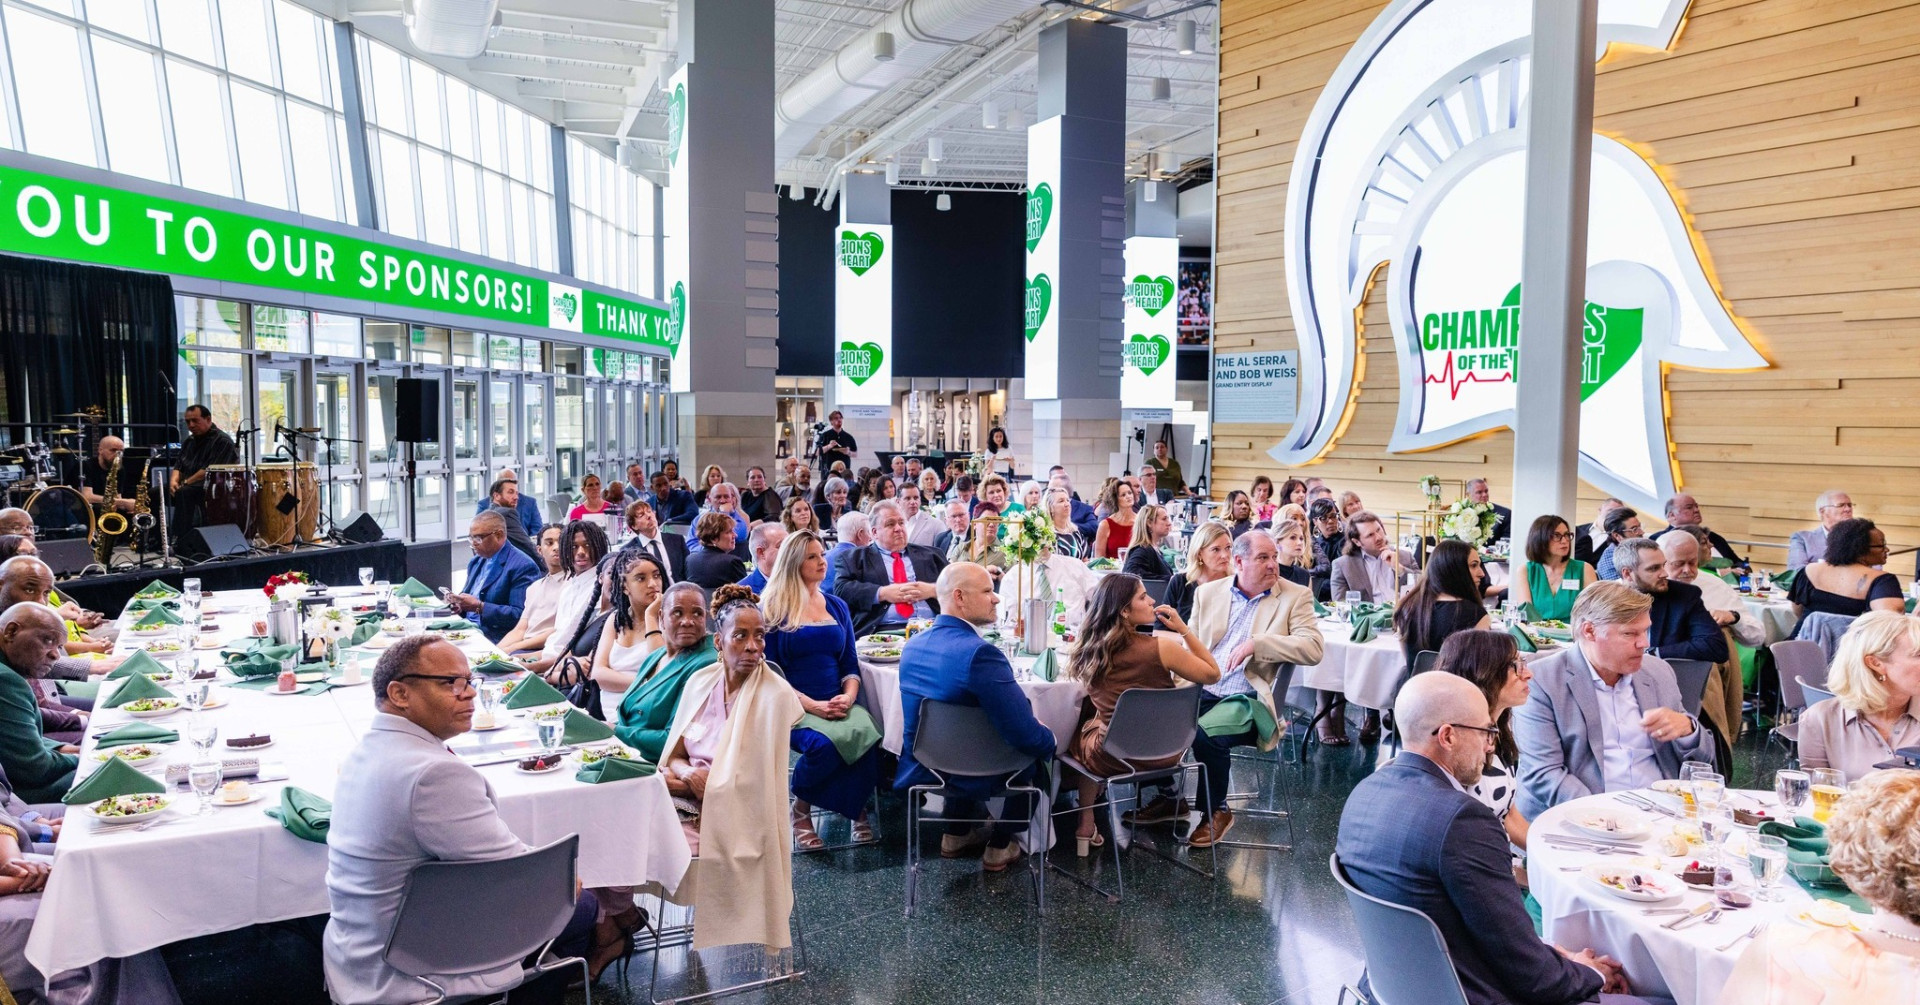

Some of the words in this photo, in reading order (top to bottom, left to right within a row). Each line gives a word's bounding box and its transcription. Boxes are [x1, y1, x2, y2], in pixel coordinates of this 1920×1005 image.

[0, 180, 111, 246] OU
[146, 208, 218, 263] TO
[246, 228, 336, 282] OUR
[358, 250, 533, 315] SPONSORS!
[1135, 297, 1162, 308] HEART
[596, 302, 648, 338] THANK
[1131, 356, 1158, 367] HEART
[1216, 358, 1235, 367] THE
[1237, 357, 1250, 367] AL
[1253, 355, 1287, 366] SERRA
[1457, 355, 1477, 370] OF
[1479, 353, 1509, 370] THE
[1216, 370, 1237, 380] AND
[1239, 369, 1261, 379] BOB
[1263, 368, 1297, 378] WEISS
